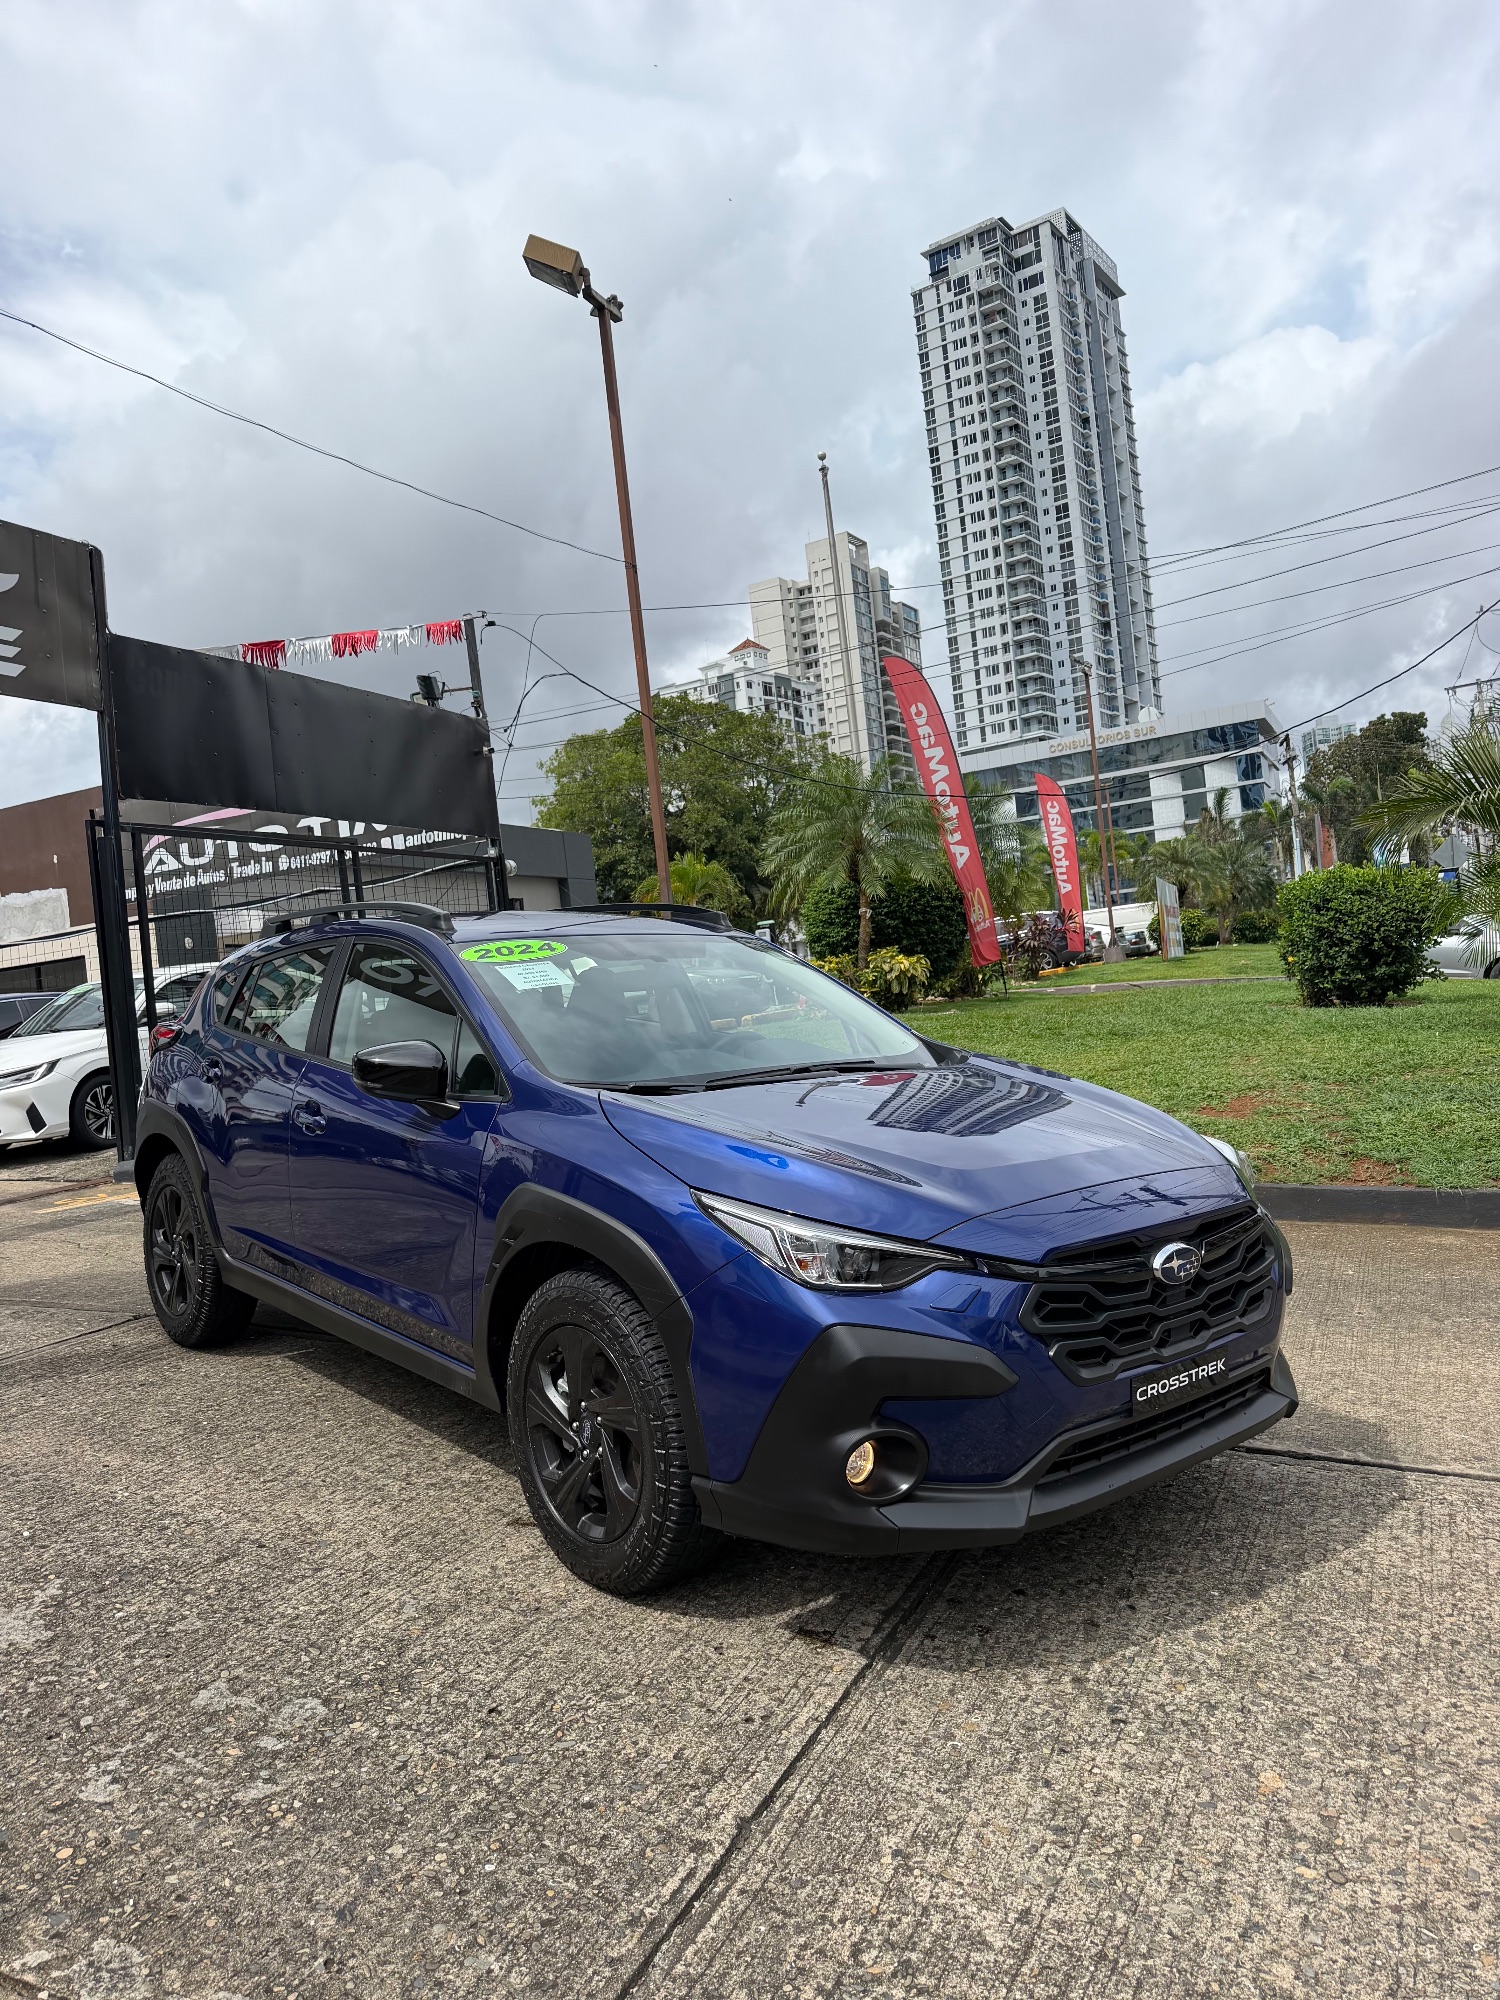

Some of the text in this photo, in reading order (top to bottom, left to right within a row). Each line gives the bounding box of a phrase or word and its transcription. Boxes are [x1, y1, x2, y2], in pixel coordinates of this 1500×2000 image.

[1049, 725, 1157, 754] CONSULORIOS SUR
[154, 876, 183, 894] Venta
[183, 871, 197, 888] de
[197, 868, 226, 886] Autos
[231, 861, 261, 879] Trade
[261, 856, 273, 873] In
[473, 942, 558, 961] 2024
[1136, 1358, 1226, 1401] CROSSTREK
